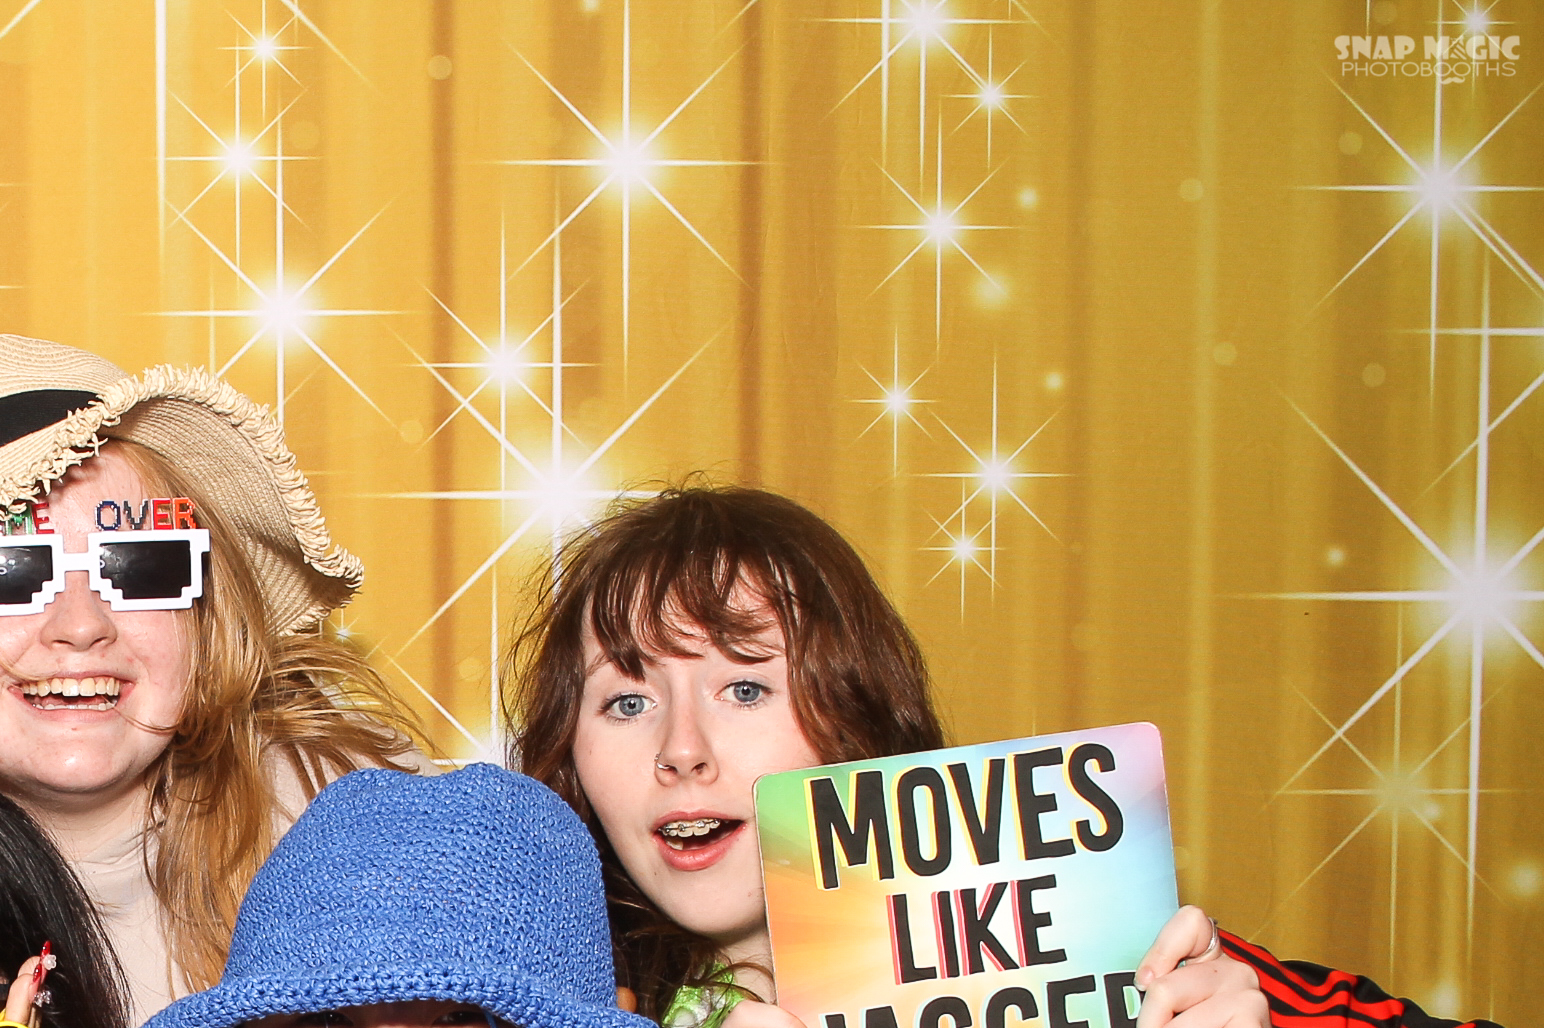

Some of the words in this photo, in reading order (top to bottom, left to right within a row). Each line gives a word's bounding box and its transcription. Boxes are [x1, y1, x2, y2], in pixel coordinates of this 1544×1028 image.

[94, 497, 199, 531] OVER
[804, 742, 1124, 890] MOVES
[886, 874, 1068, 985] LIKE
